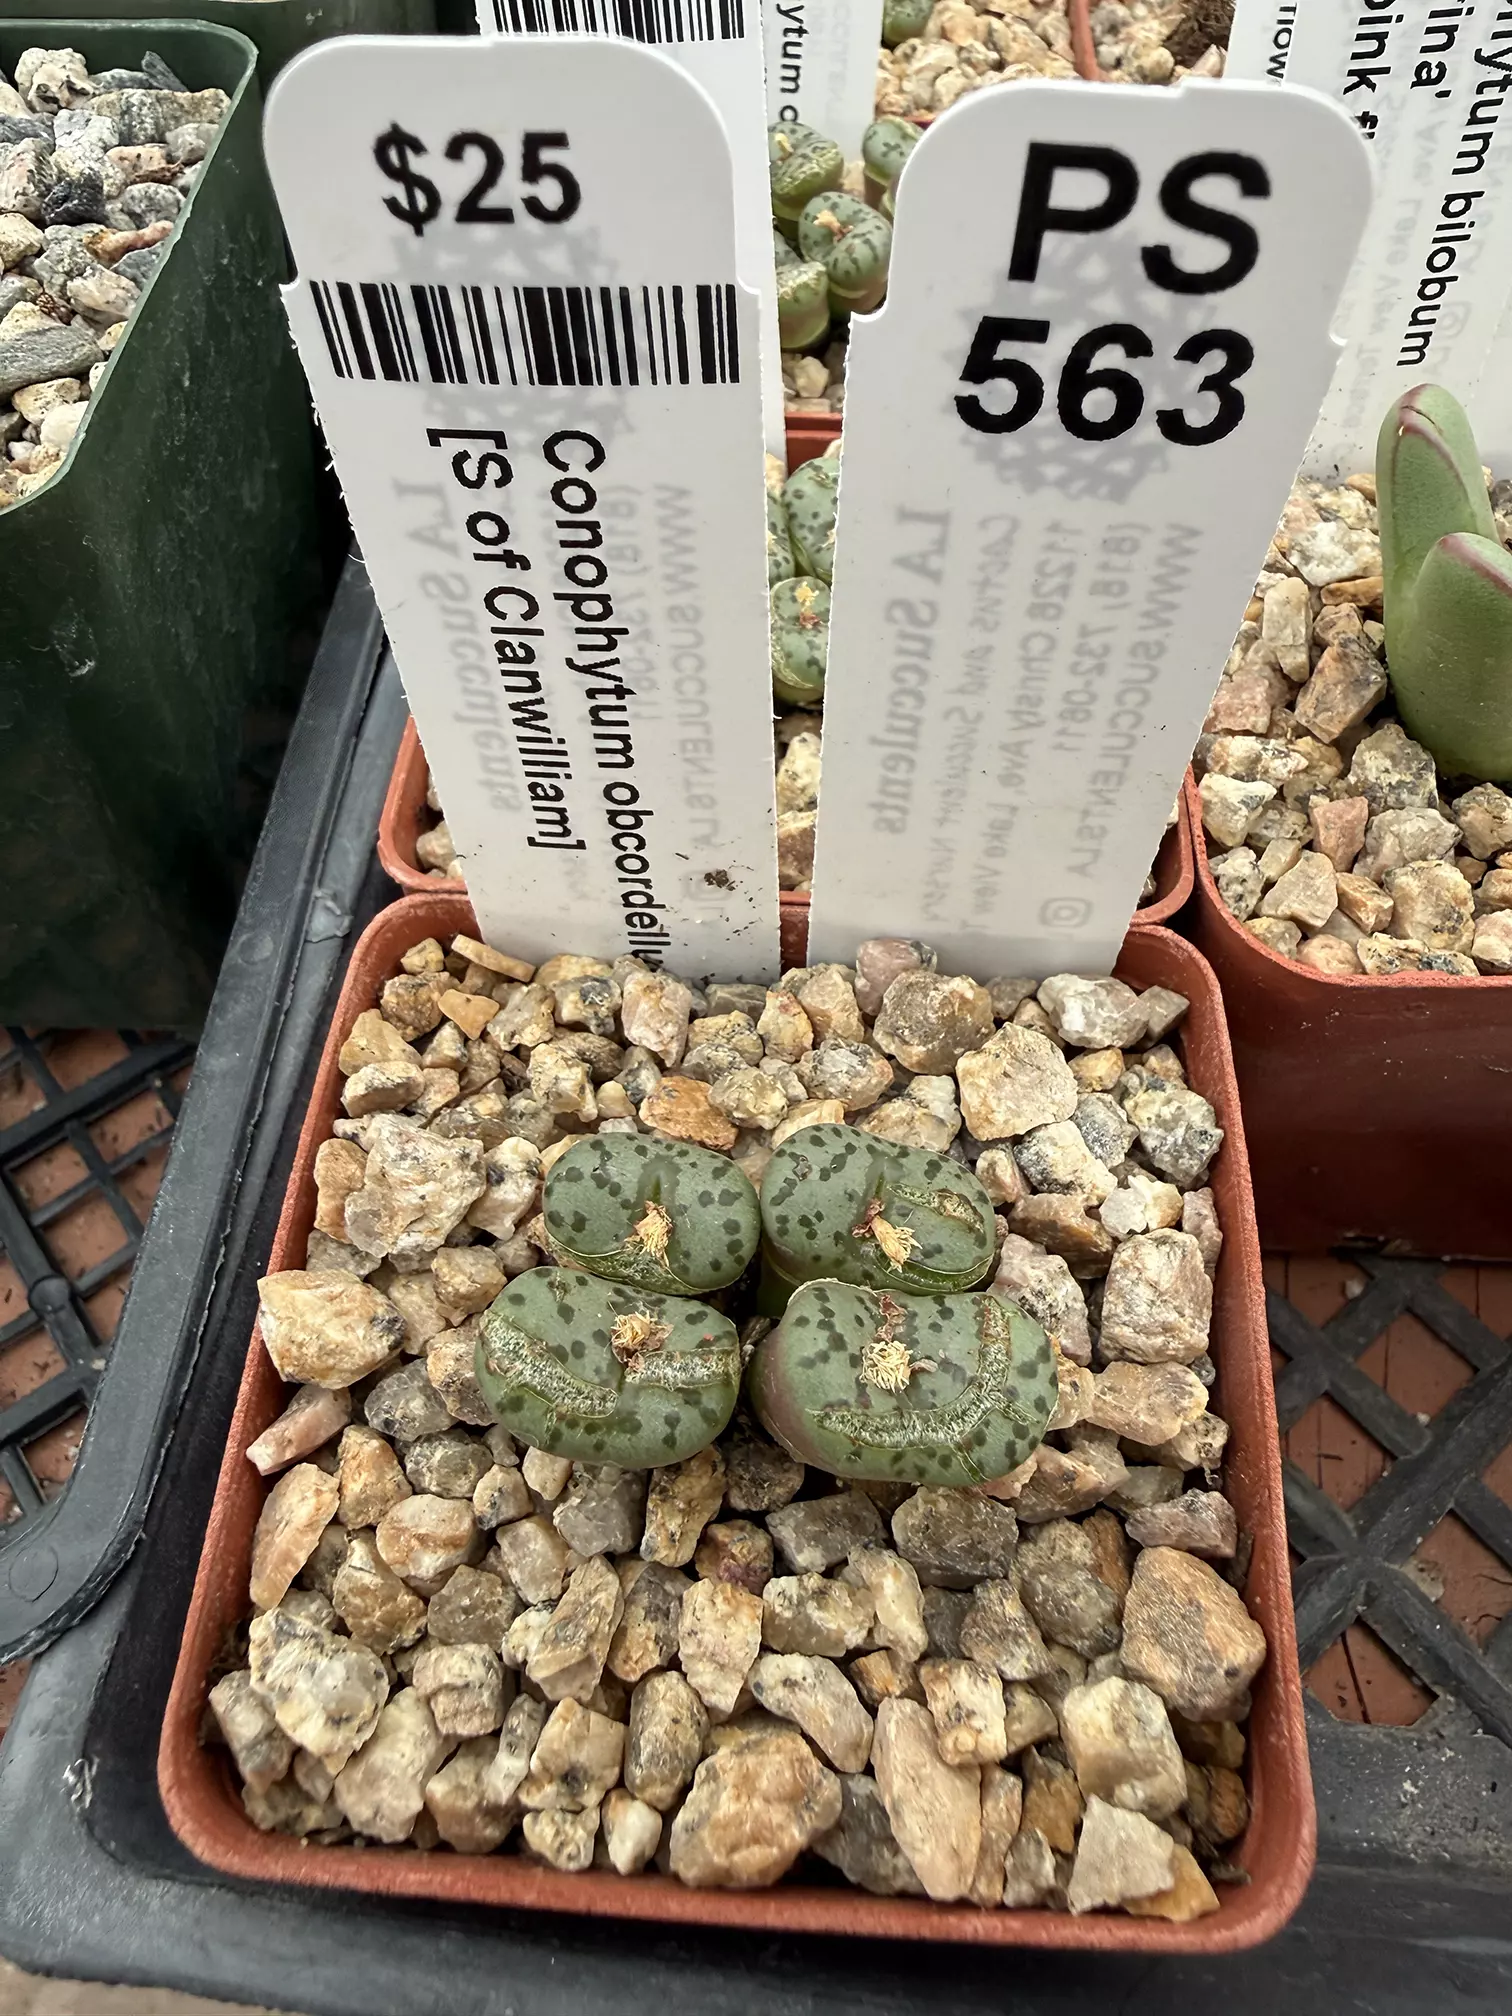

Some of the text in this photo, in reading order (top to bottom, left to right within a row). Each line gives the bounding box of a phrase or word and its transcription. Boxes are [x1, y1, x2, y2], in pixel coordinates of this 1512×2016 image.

[1410, 5, 1475, 99] ina'
[372, 122, 582, 238] $25
[1008, 141, 1271, 297] PS
[1396, 190, 1485, 367] bilobum
[953, 315, 1255, 447] 563
[425, 427, 587, 851] [S of Clanwilliam]
[542, 429, 637, 769] Conophytum
[602, 781, 672, 967] obcordellu
